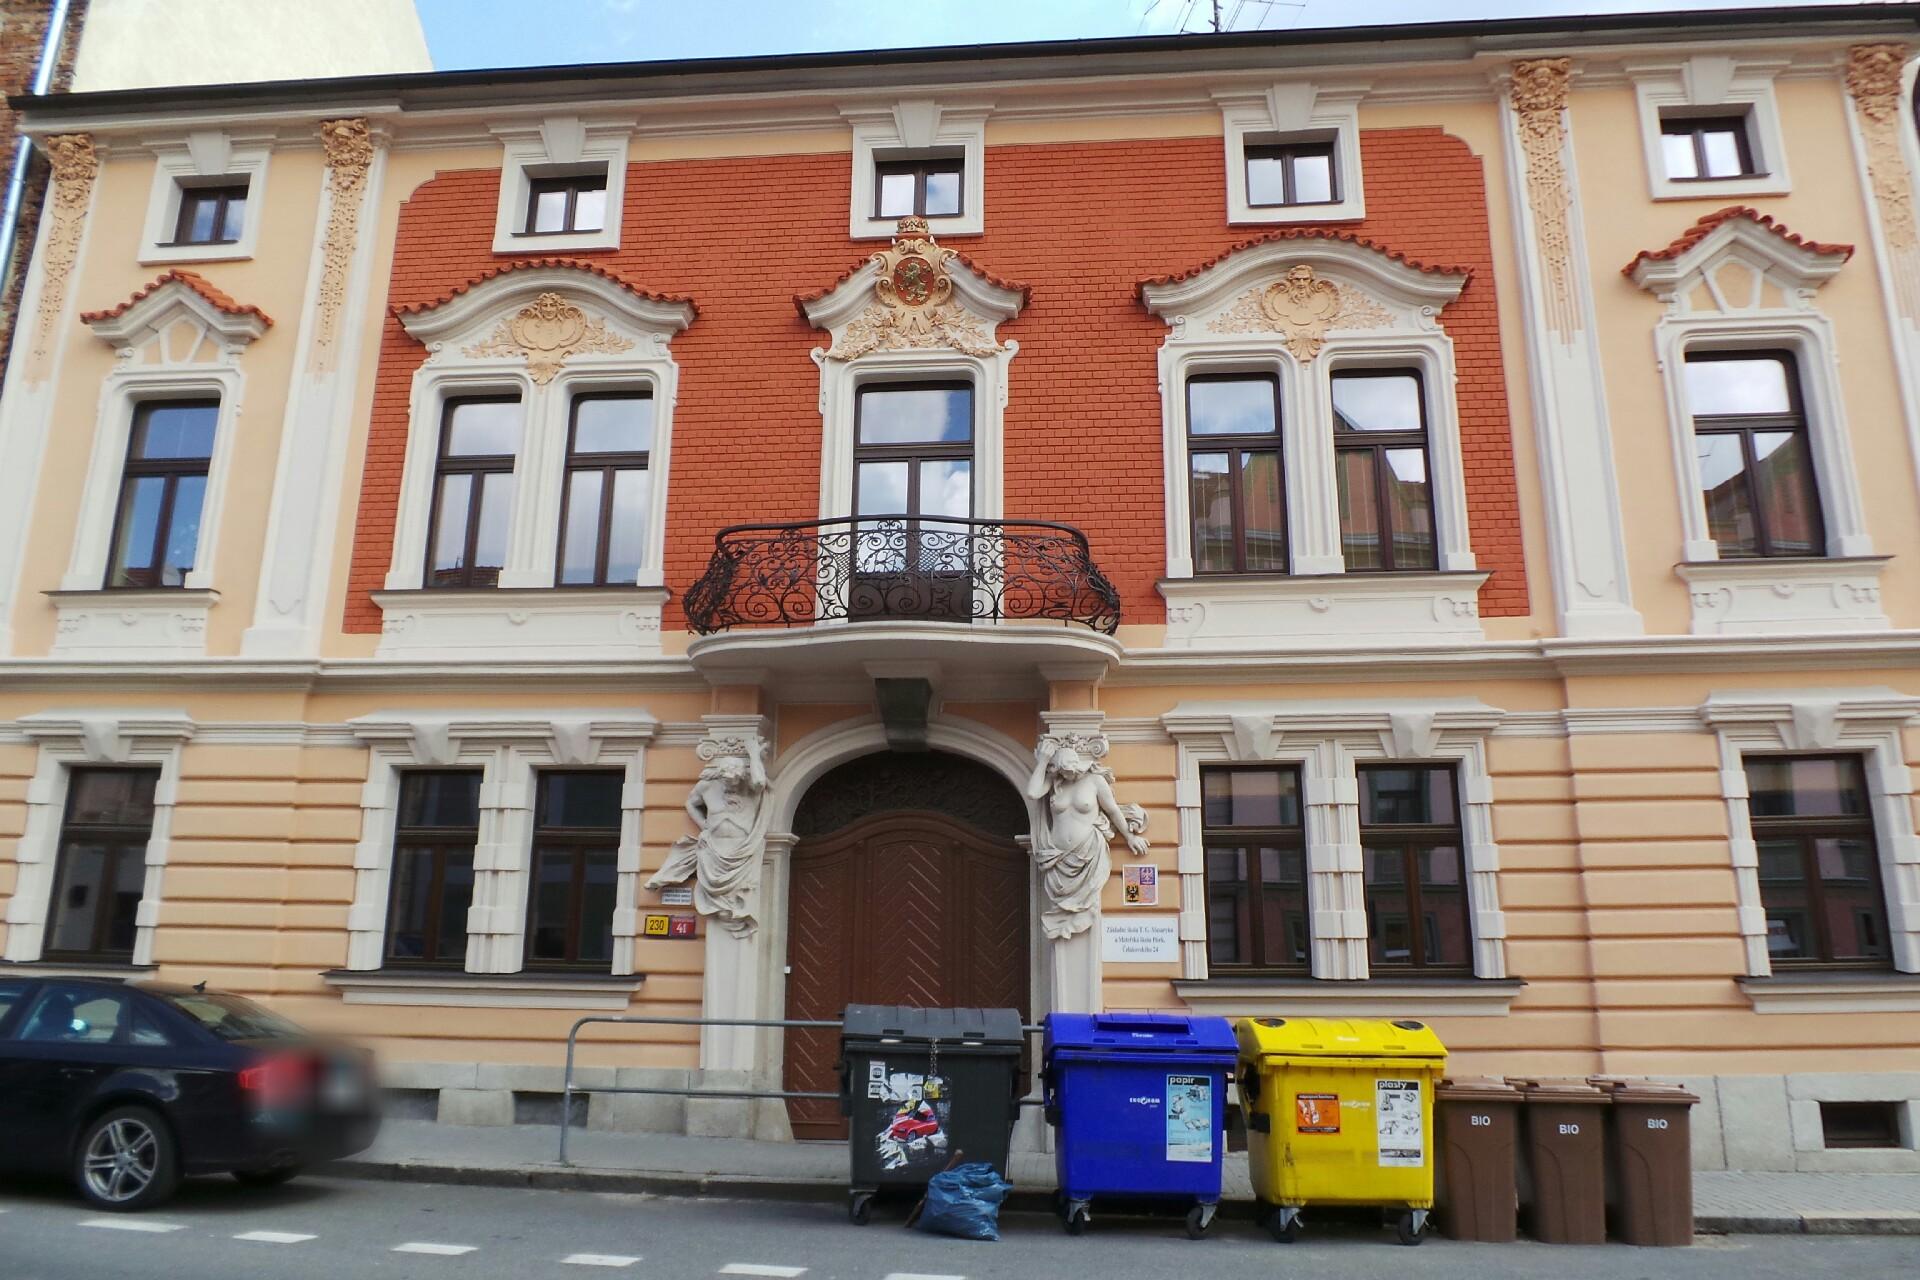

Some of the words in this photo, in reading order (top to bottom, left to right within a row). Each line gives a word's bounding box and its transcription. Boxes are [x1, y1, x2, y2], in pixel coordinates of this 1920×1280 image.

[649, 919, 664, 930] 230
[676, 923, 686, 933] 41
[1378, 1080, 1407, 1090] plasty
[1471, 1115, 1491, 1126] BIO
[1647, 1119, 1668, 1130] BIO
[1559, 1124, 1579, 1135] BIO
